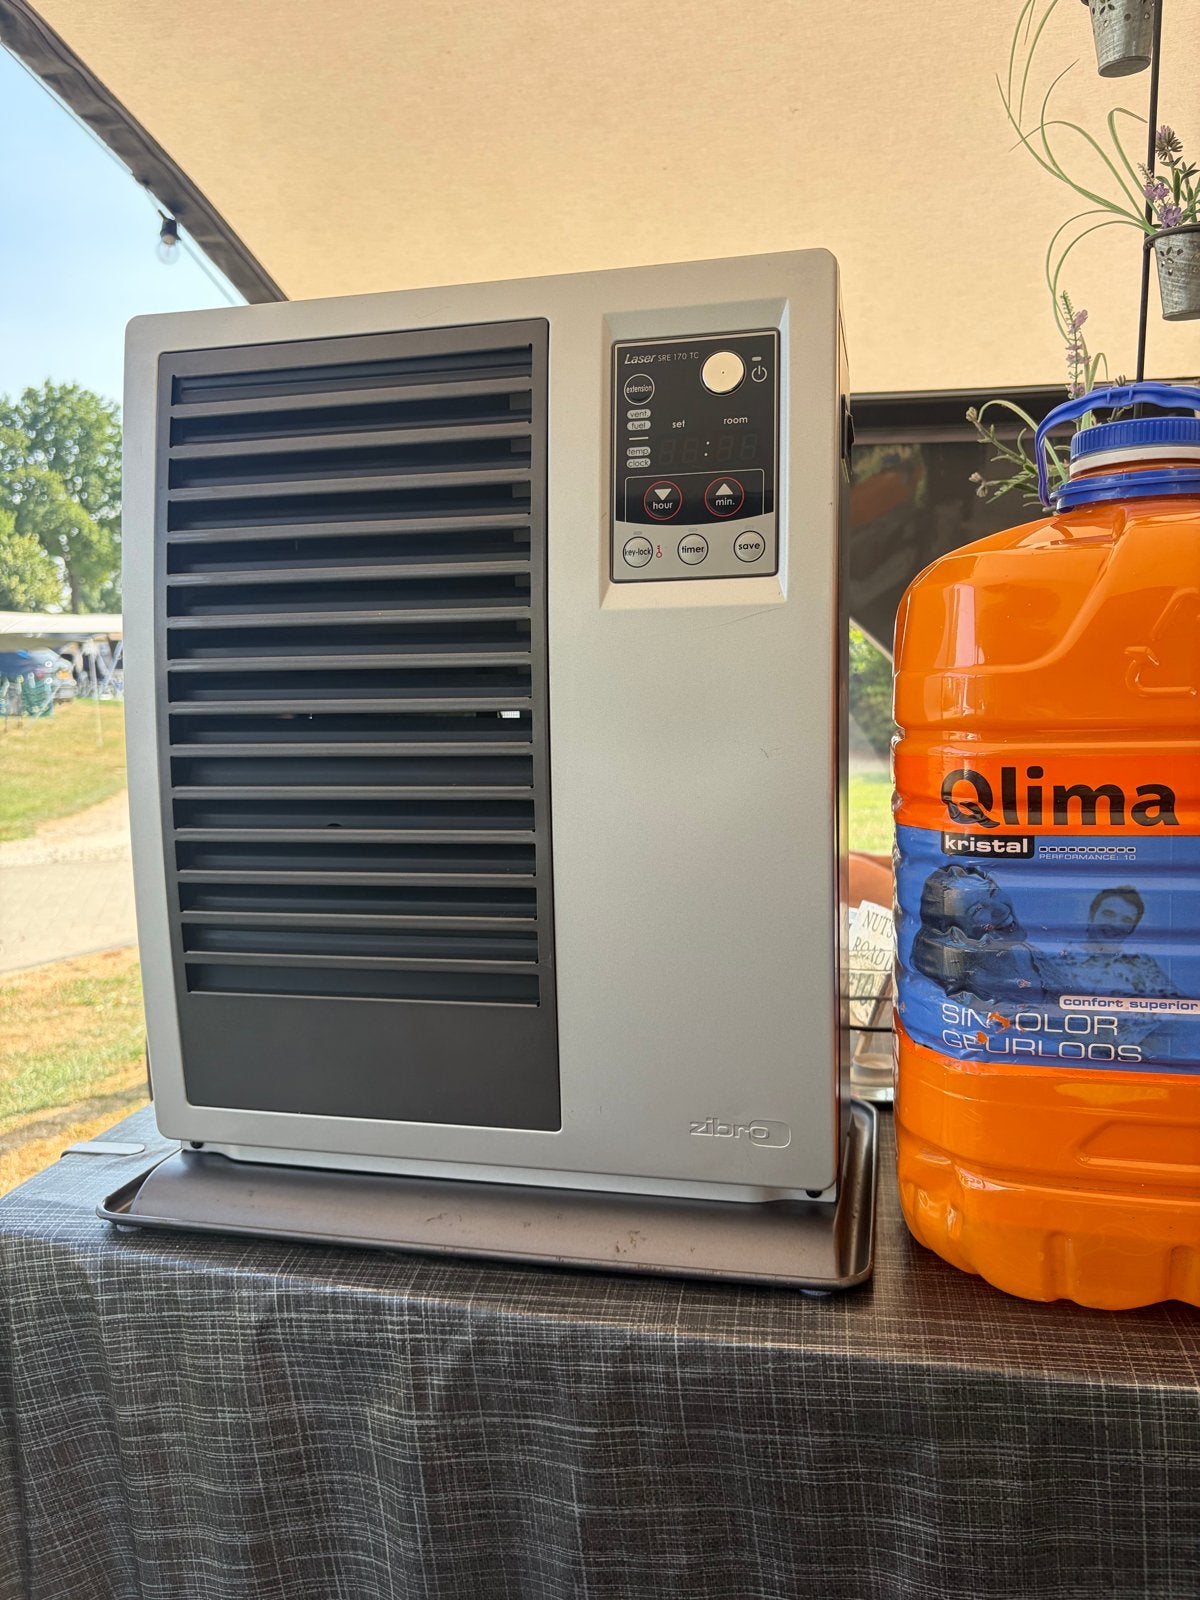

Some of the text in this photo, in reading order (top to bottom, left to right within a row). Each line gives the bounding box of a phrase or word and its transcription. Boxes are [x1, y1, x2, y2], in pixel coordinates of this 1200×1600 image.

[625, 351, 699, 365] Laser SRE 170 TC
[626, 384, 652, 394] extension
[631, 421, 646, 430] fuel
[672, 416, 748, 429] set room
[627, 458, 650, 467] clock
[652, 497, 735, 510] hour min.
[681, 544, 705, 554] timer
[737, 542, 761, 551] save
[941, 766, 1180, 828] Qlima
[945, 836, 1029, 853] kristal
[1124, 853, 1137, 861] 10
[1063, 998, 1199, 1011] confort superior
[942, 1029, 1142, 1063] GEURLOOS
[689, 1117, 769, 1140] zibro
